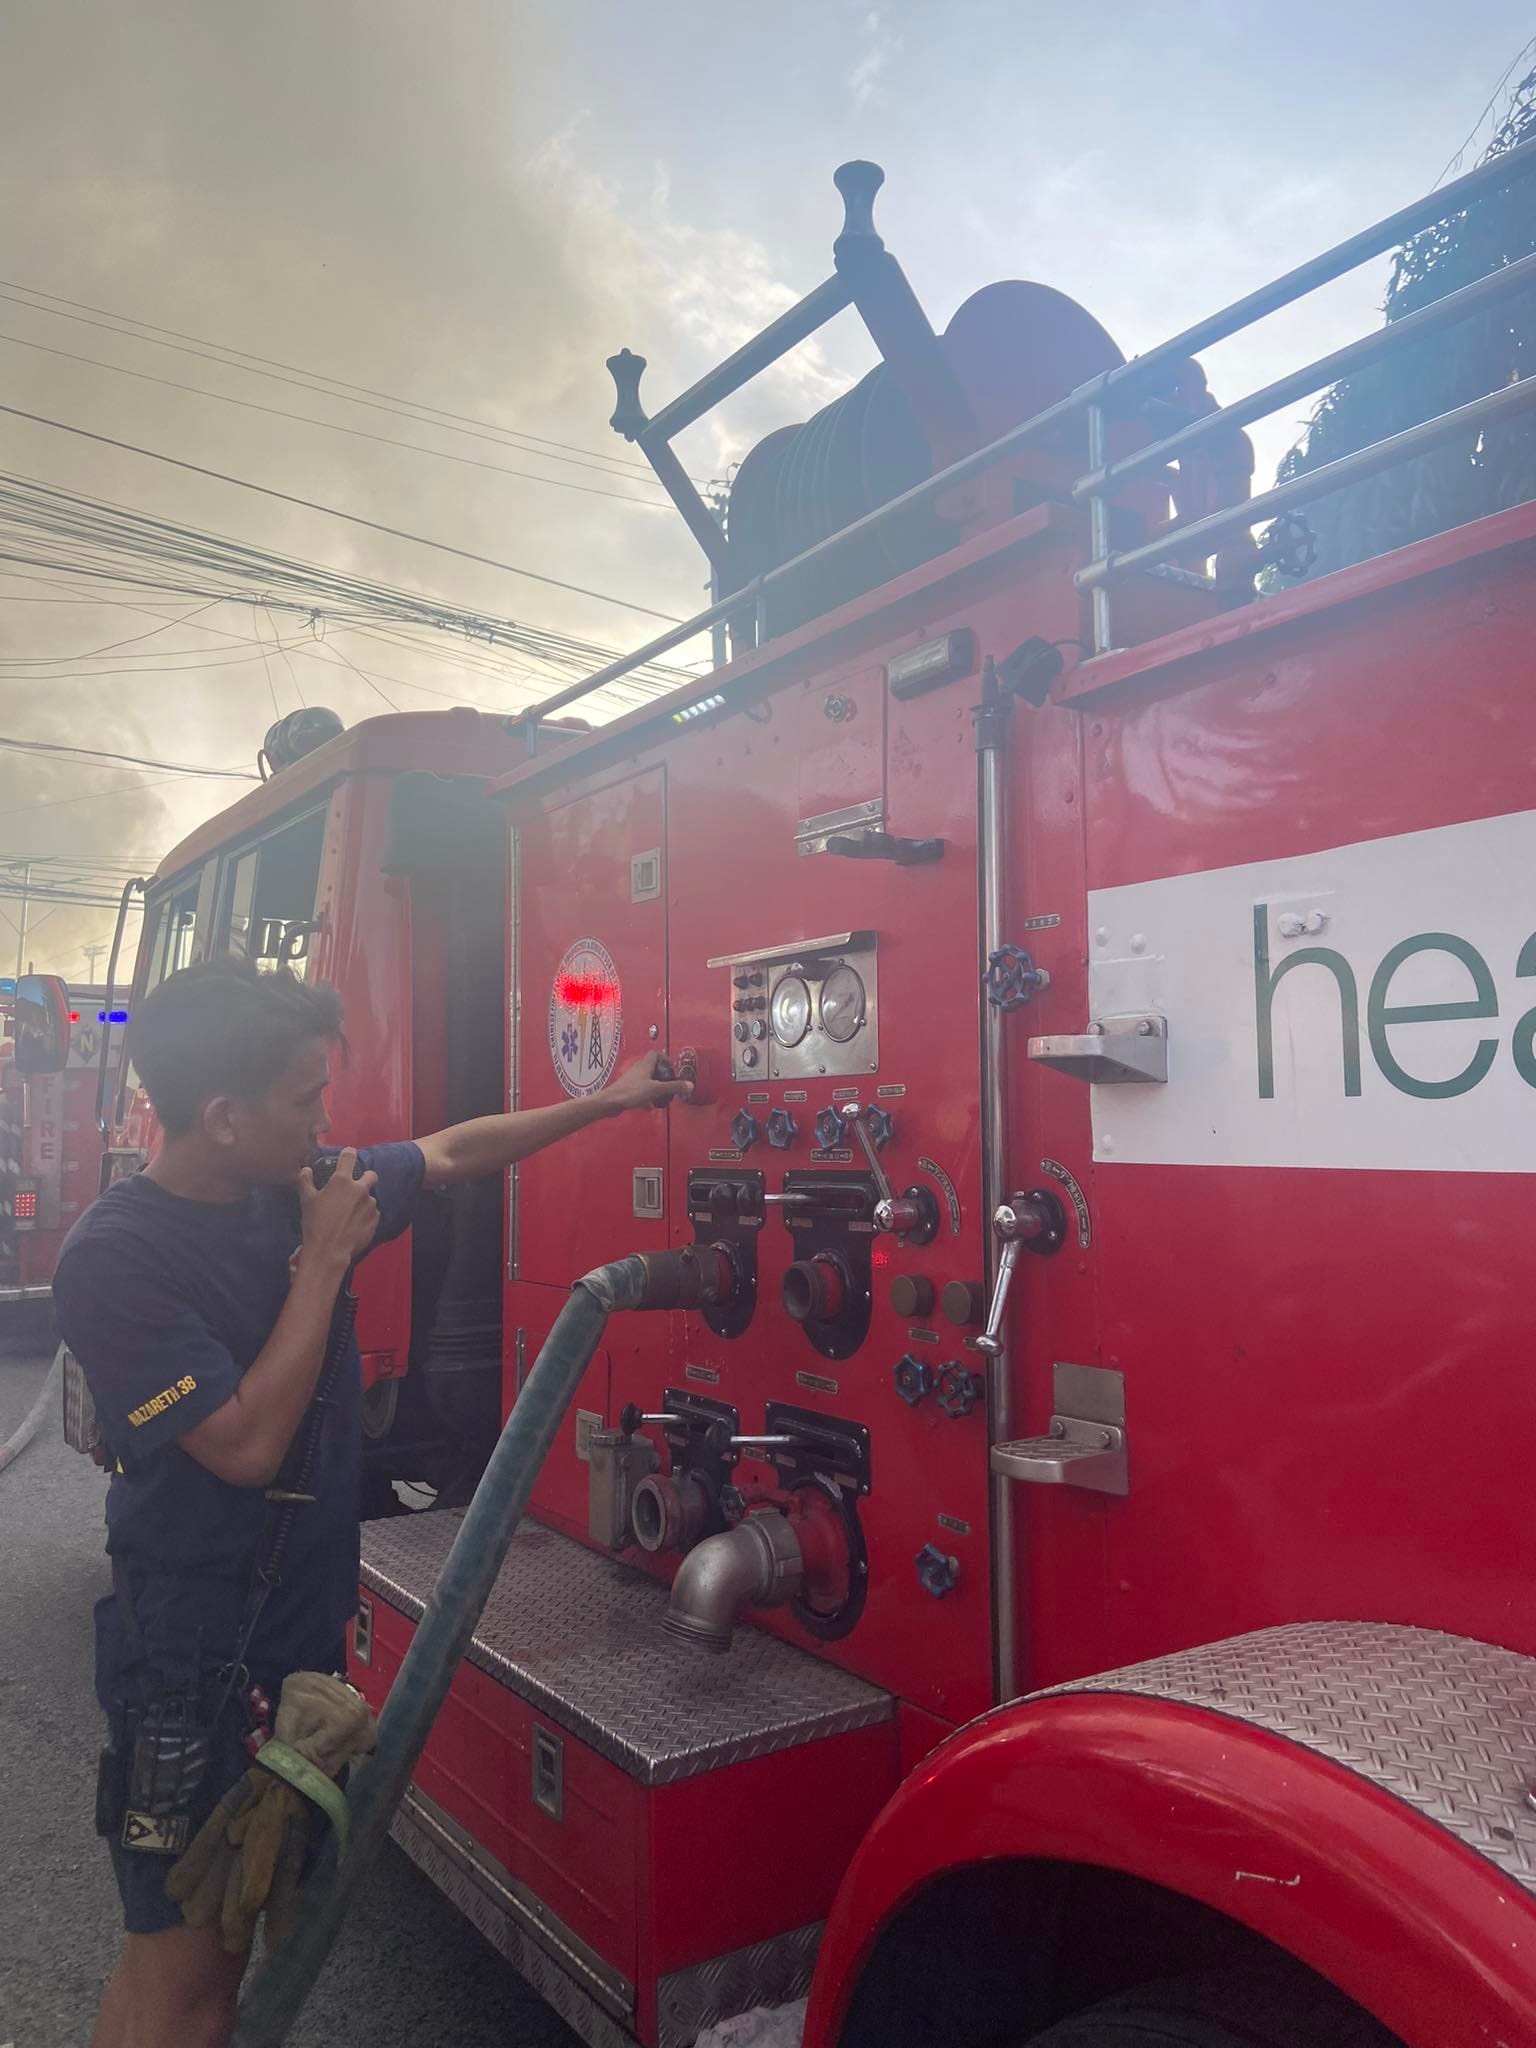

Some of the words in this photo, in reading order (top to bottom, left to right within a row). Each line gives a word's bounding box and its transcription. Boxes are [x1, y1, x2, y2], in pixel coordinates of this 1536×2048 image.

[1254, 904, 1536, 1099] he
[80, 1035, 94, 1053] N
[40, 1075, 56, 1160] FIRE
[128, 1387, 181, 1425] NAZARETH
[177, 1375, 197, 1395] 38
